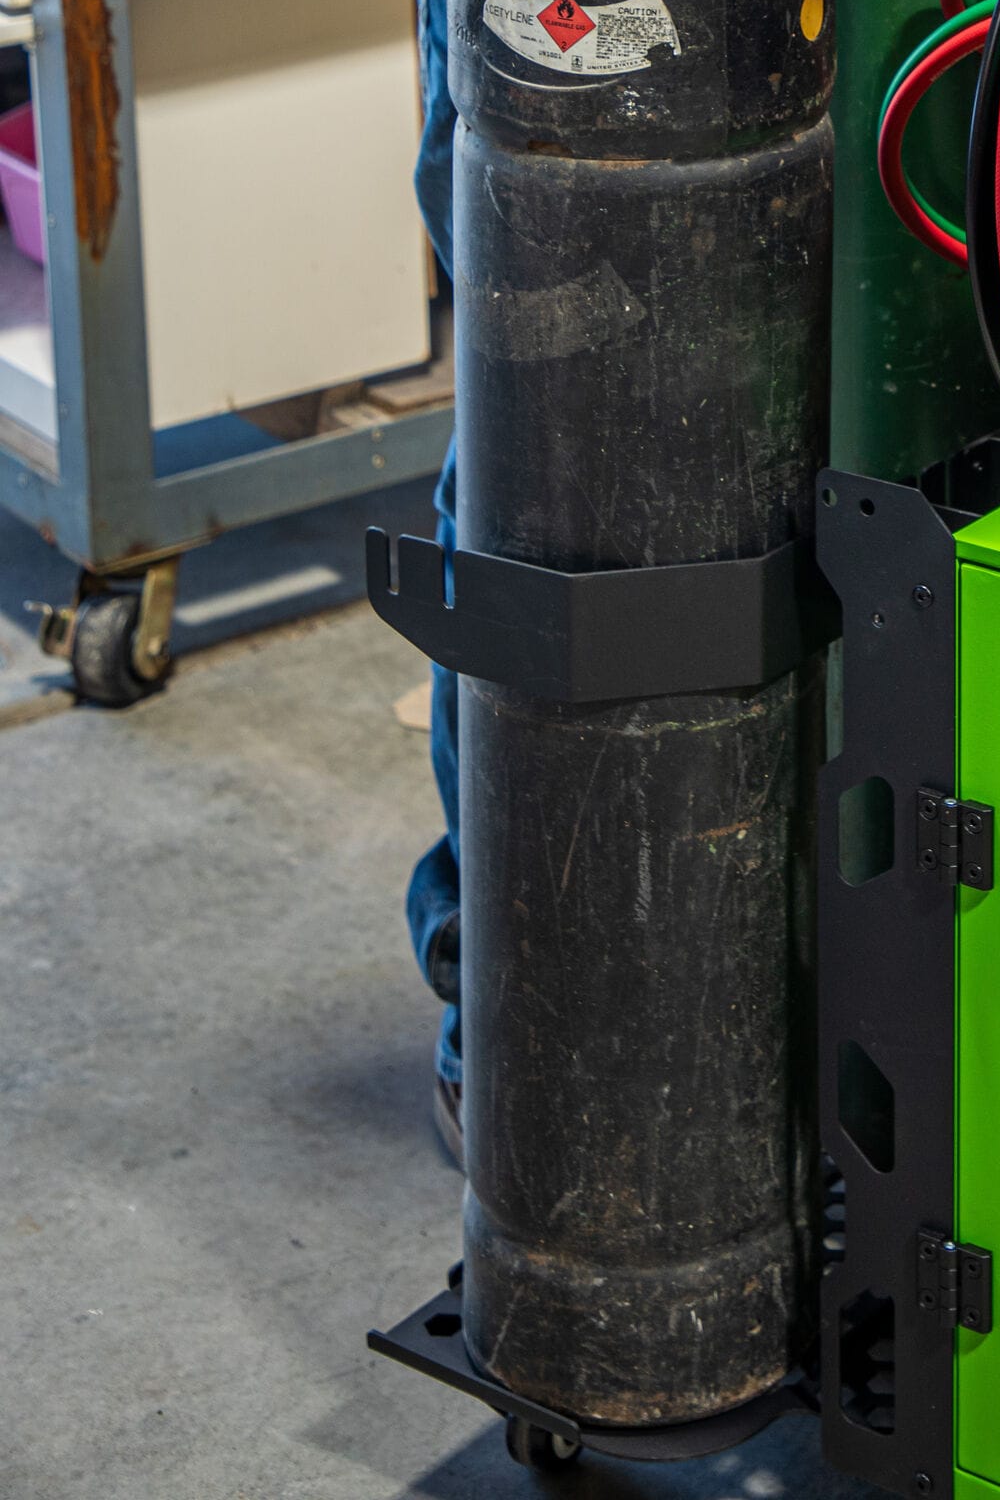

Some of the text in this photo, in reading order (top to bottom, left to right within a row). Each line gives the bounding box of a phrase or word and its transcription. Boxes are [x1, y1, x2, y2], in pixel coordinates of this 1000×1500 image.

[618, 6, 662, 17] CAUTION!
[545, 19, 586, 31] FLAMMABLE GAS
[561, 41, 567, 49] 2
